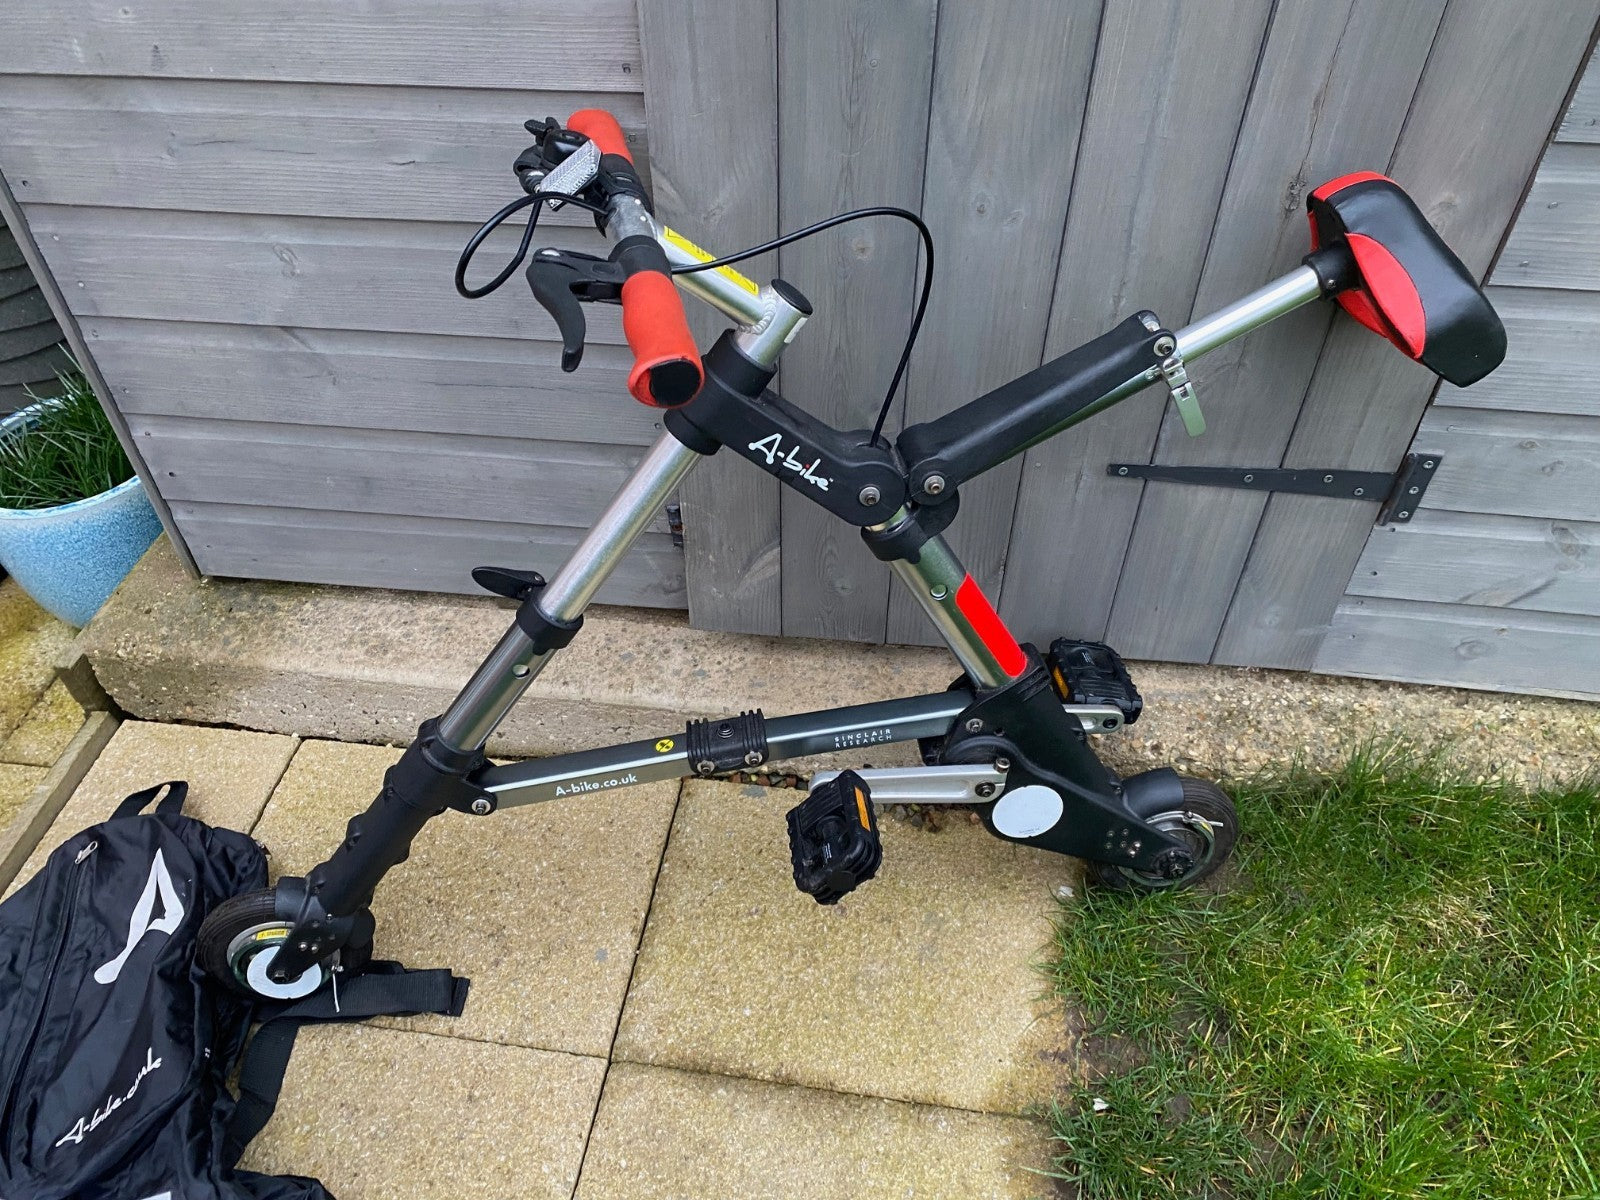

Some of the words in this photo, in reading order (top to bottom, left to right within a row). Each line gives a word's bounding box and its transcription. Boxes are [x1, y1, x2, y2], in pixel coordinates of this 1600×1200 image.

[748, 433, 829, 491] A-bike
[834, 728, 891, 742] SINCLAIR
[835, 734, 892, 748] RESEARCH
[555, 773, 638, 796] A-bike.co.uk
